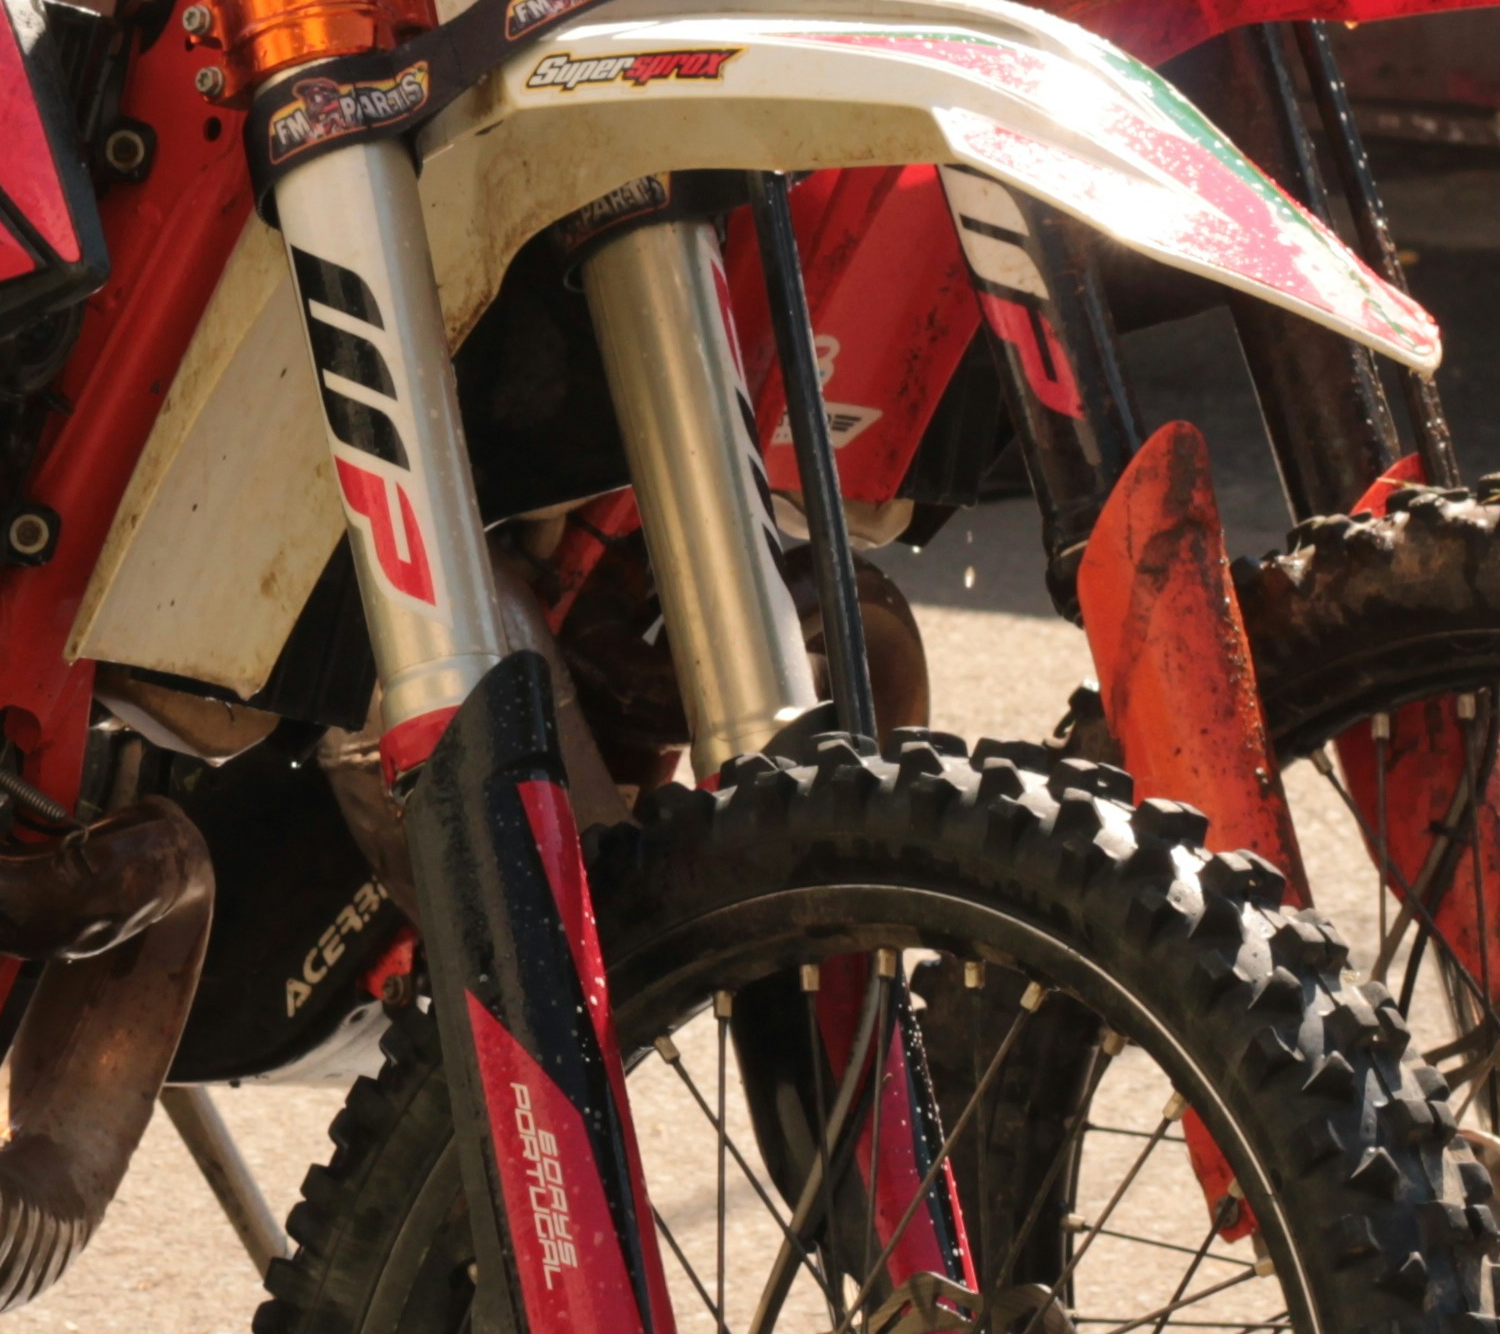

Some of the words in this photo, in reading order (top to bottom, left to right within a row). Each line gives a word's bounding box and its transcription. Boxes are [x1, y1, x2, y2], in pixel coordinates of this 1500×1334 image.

[275, 108, 313, 146] FM
[339, 74, 424, 124] PARTS
[510, 1082, 562, 1291] PORTUGAL
